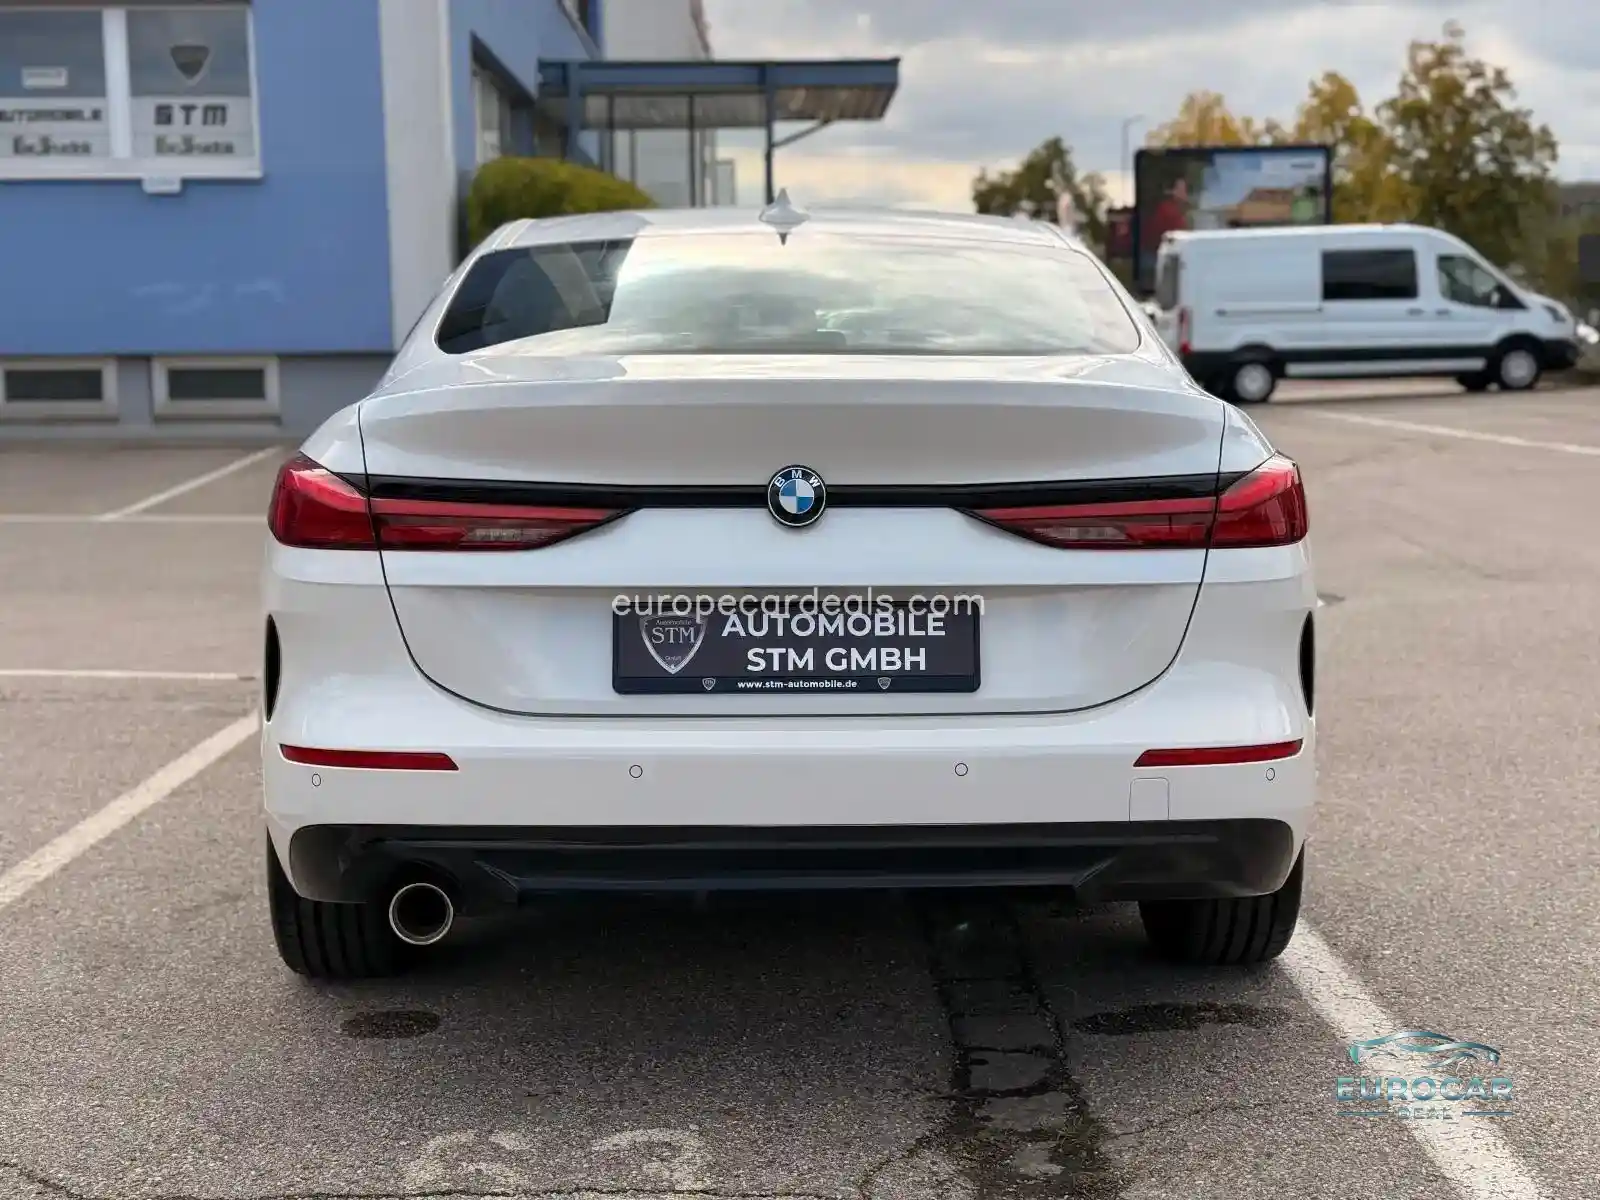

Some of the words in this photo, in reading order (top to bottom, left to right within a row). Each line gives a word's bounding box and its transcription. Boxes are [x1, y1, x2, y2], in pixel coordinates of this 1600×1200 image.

[774, 470, 821, 488] BMW
[721, 613, 946, 637] AUTOMOBILE
[651, 627, 695, 644] STM
[747, 647, 814, 672] STM
[825, 647, 926, 672] GMBH
[737, 680, 858, 689] www.stm-automobile.de
